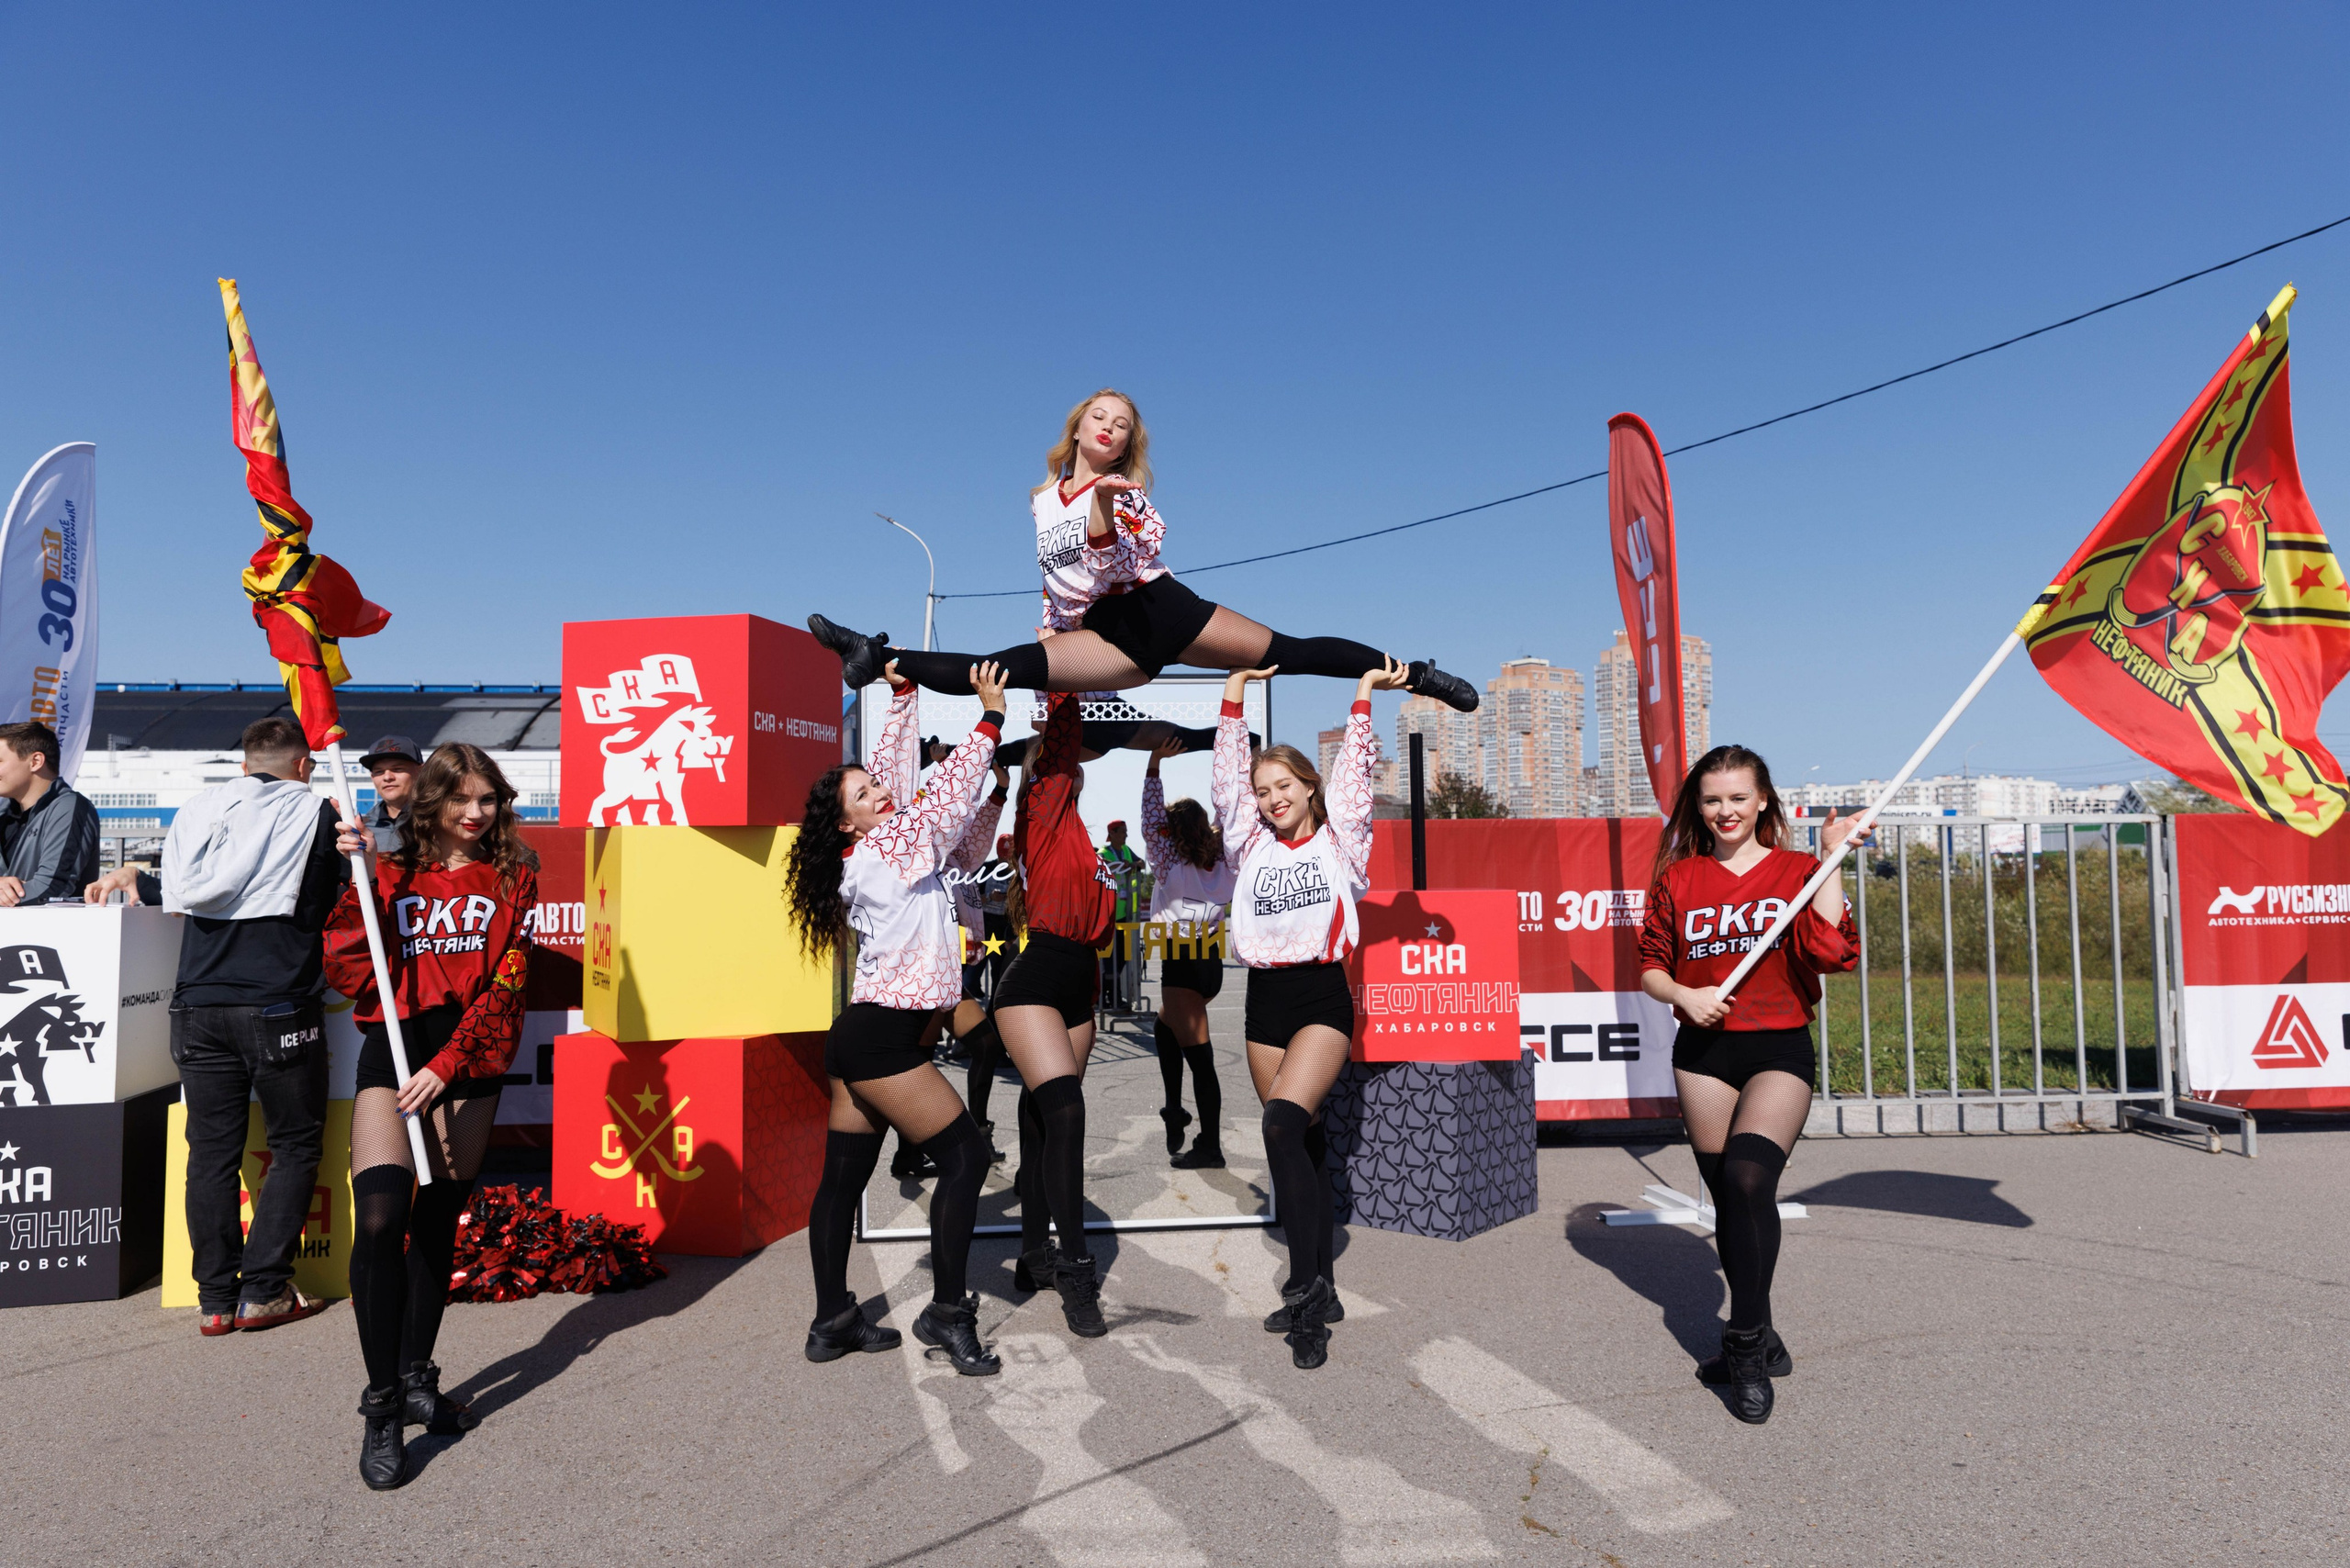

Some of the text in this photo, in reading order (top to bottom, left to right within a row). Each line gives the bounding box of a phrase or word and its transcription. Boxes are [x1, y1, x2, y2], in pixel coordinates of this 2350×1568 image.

[59, 519, 71, 561] РЫНКЕ
[38, 578, 77, 653] 30
[2090, 619, 2189, 712] НЕФТЯНИК
[591, 659, 679, 718] СКА
[754, 711, 837, 744] СКА НЕФТЯНИК
[1253, 857, 1328, 899] СКА
[395, 894, 498, 937] СКА
[533, 902, 586, 934] АВТО
[1254, 887, 1331, 916] НЕФТЯНИК
[1516, 890, 1542, 921] ТО
[1554, 890, 1639, 932] 30 ЛЕТ
[1608, 910, 1621, 918] НА
[1684, 897, 1789, 943] СКА
[2208, 915, 2346, 927] АВТОТЕХНИКА СЕРВИС
[593, 922, 611, 969] СКА
[1401, 944, 1467, 975] СКА
[280, 1026, 319, 1048] ICE PLAY
[1375, 1022, 1496, 1034] ХАБАРОВСК
[0, 1206, 121, 1249] ЯНИК
